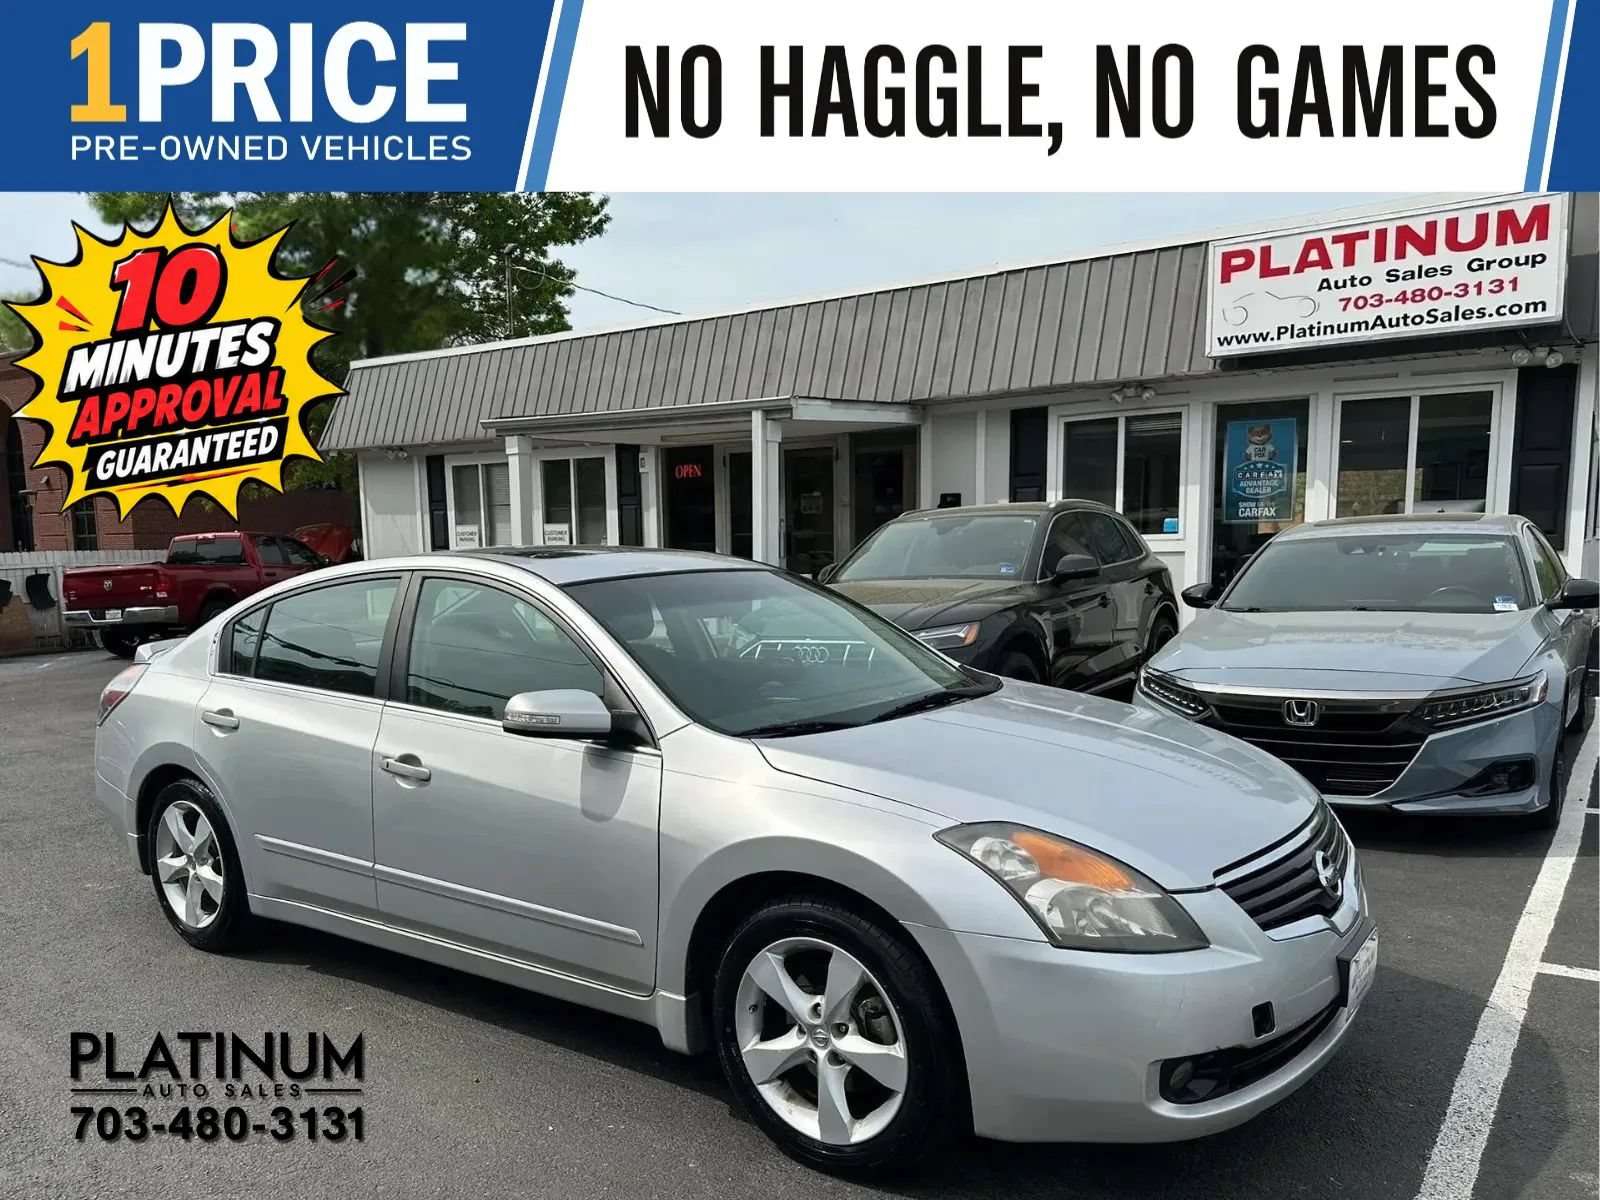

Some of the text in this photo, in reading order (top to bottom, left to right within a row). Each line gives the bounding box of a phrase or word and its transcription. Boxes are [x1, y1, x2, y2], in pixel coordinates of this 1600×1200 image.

[1220, 203, 1551, 284] PLATINUM
[1317, 252, 1548, 292] Auto Sales Group
[1338, 276, 1519, 312] 703-480-3131
[1217, 299, 1548, 347] www.PlatinumAutoSales.com
[675, 464, 702, 479] OPEN
[1237, 470, 1282, 479] CARFAX
[1238, 507, 1277, 517] CARFAX
